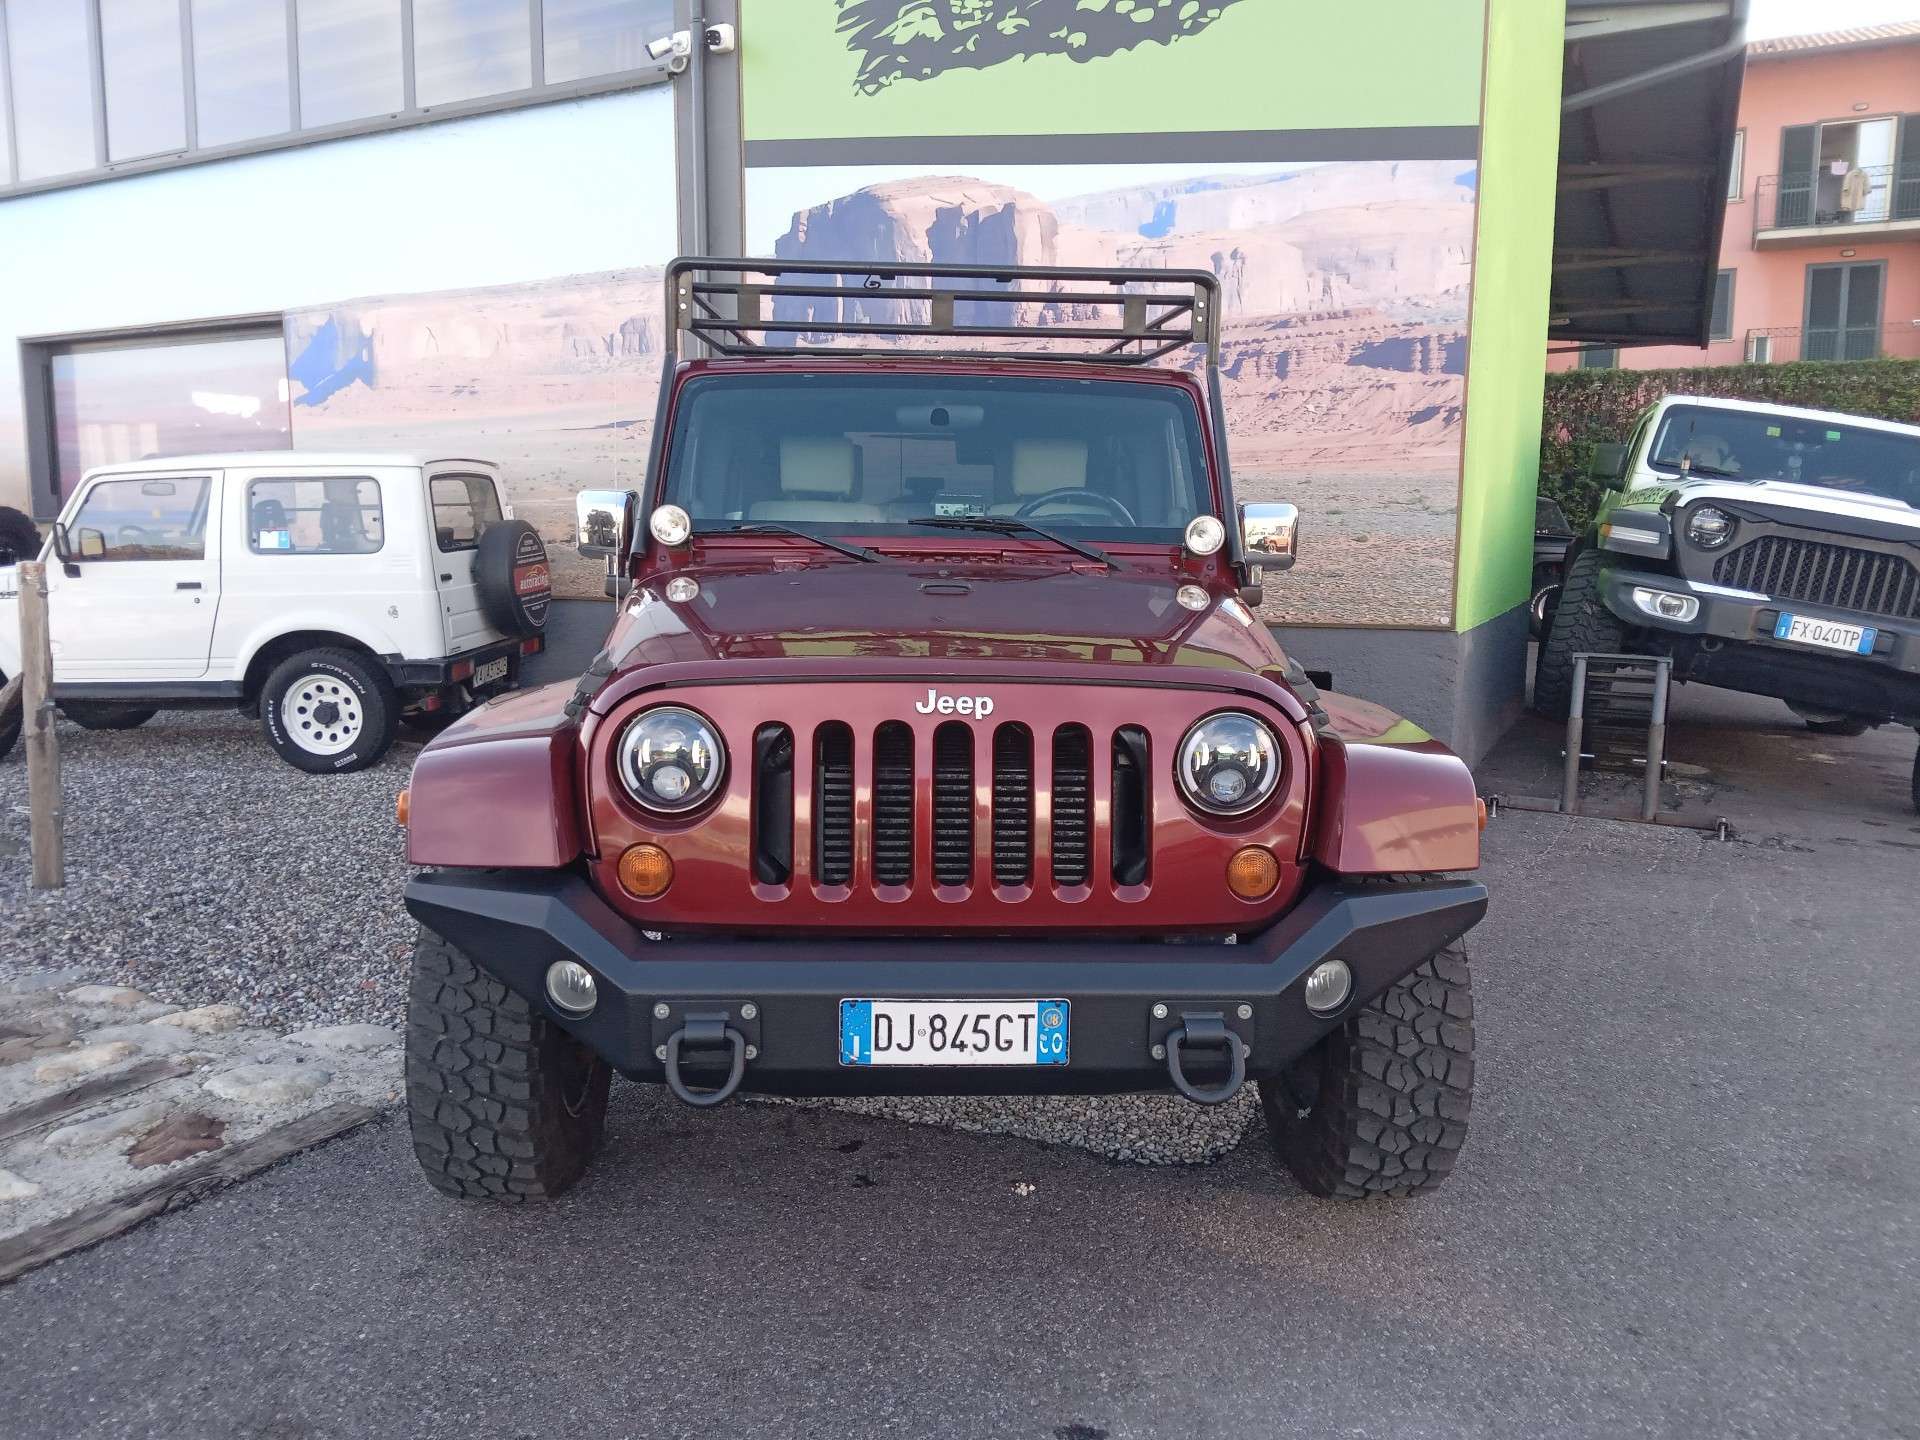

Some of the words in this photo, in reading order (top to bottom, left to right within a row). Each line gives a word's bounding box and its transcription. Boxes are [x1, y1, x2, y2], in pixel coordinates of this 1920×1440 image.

[1790, 620, 1811, 638] FX
[1812, 625, 1860, 646] 040TP
[311, 662, 366, 694] SCORPION
[915, 688, 994, 720] Jeep
[268, 700, 284, 744] PIRELLI
[874, 1013, 915, 1052] DJ
[929, 1013, 1036, 1052] 845GT
